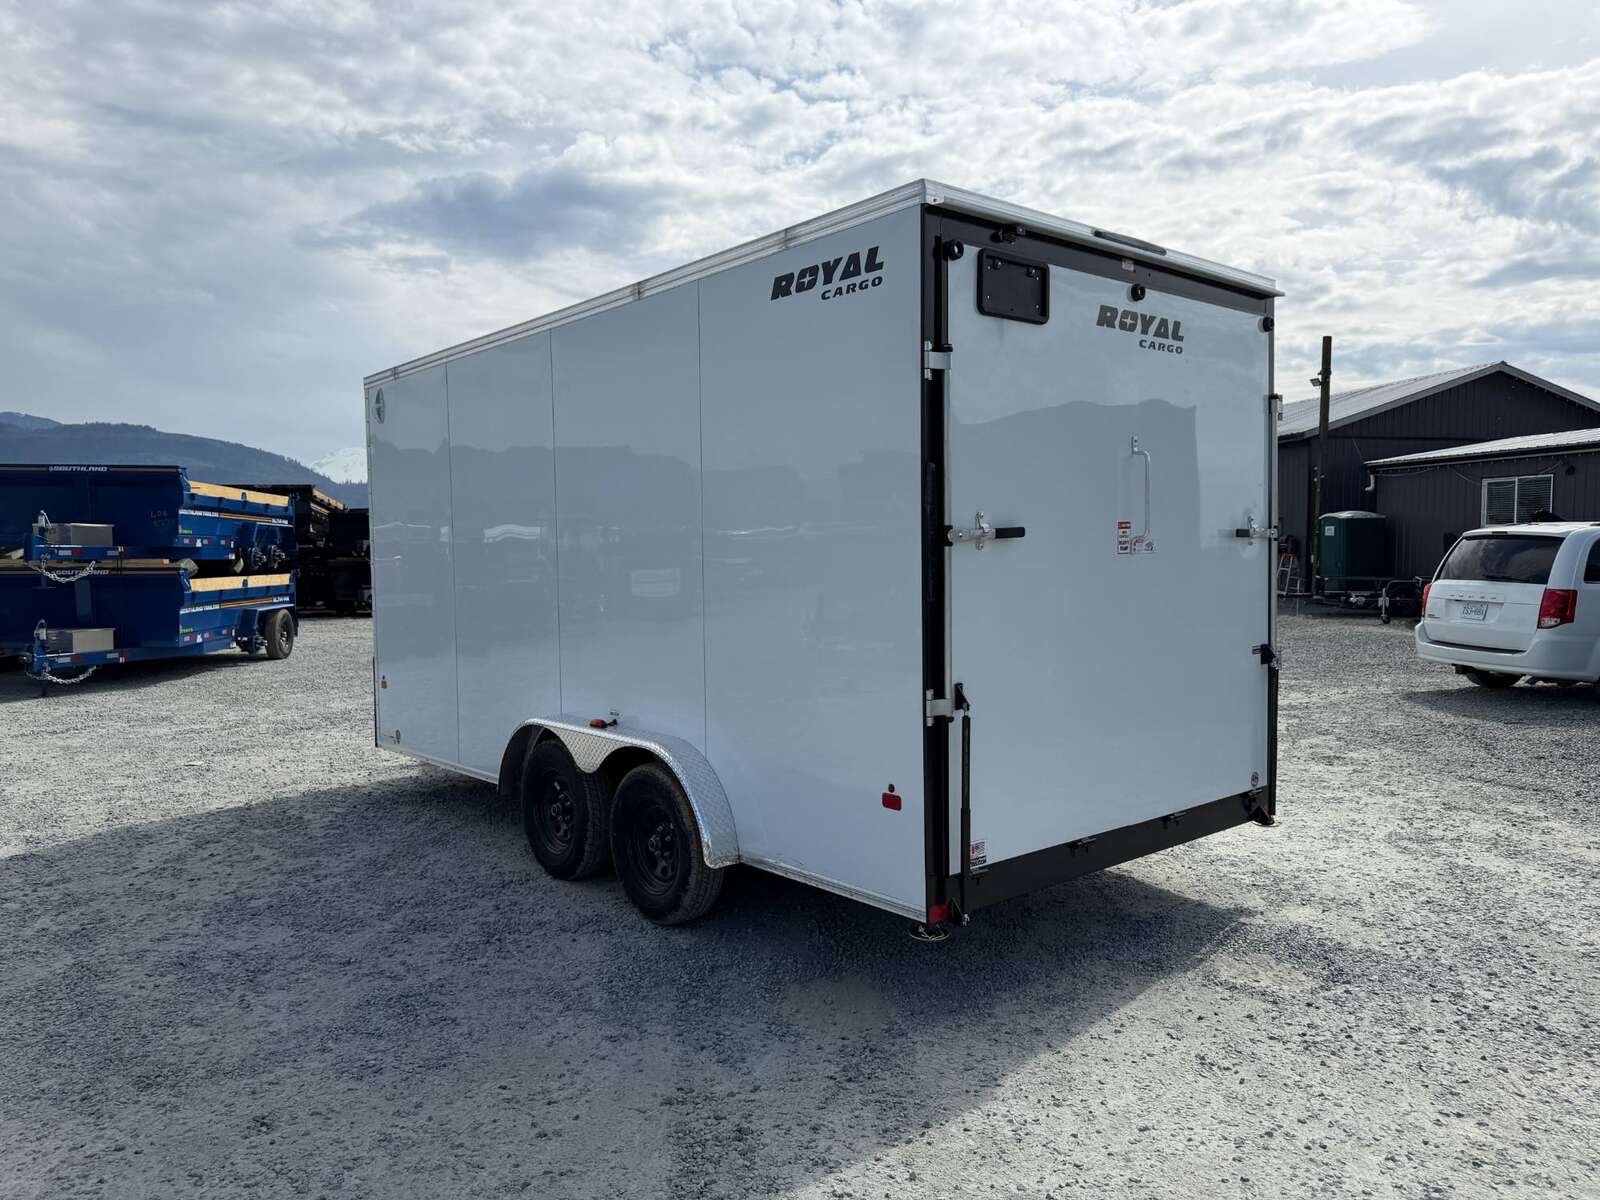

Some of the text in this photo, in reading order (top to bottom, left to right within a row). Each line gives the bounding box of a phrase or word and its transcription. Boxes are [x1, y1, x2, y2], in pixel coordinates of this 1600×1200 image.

[771, 246, 884, 300] ROYAL
[821, 275, 883, 301] CARGO
[1096, 304, 1185, 342] ROYAL
[1138, 339, 1184, 355] CARGO
